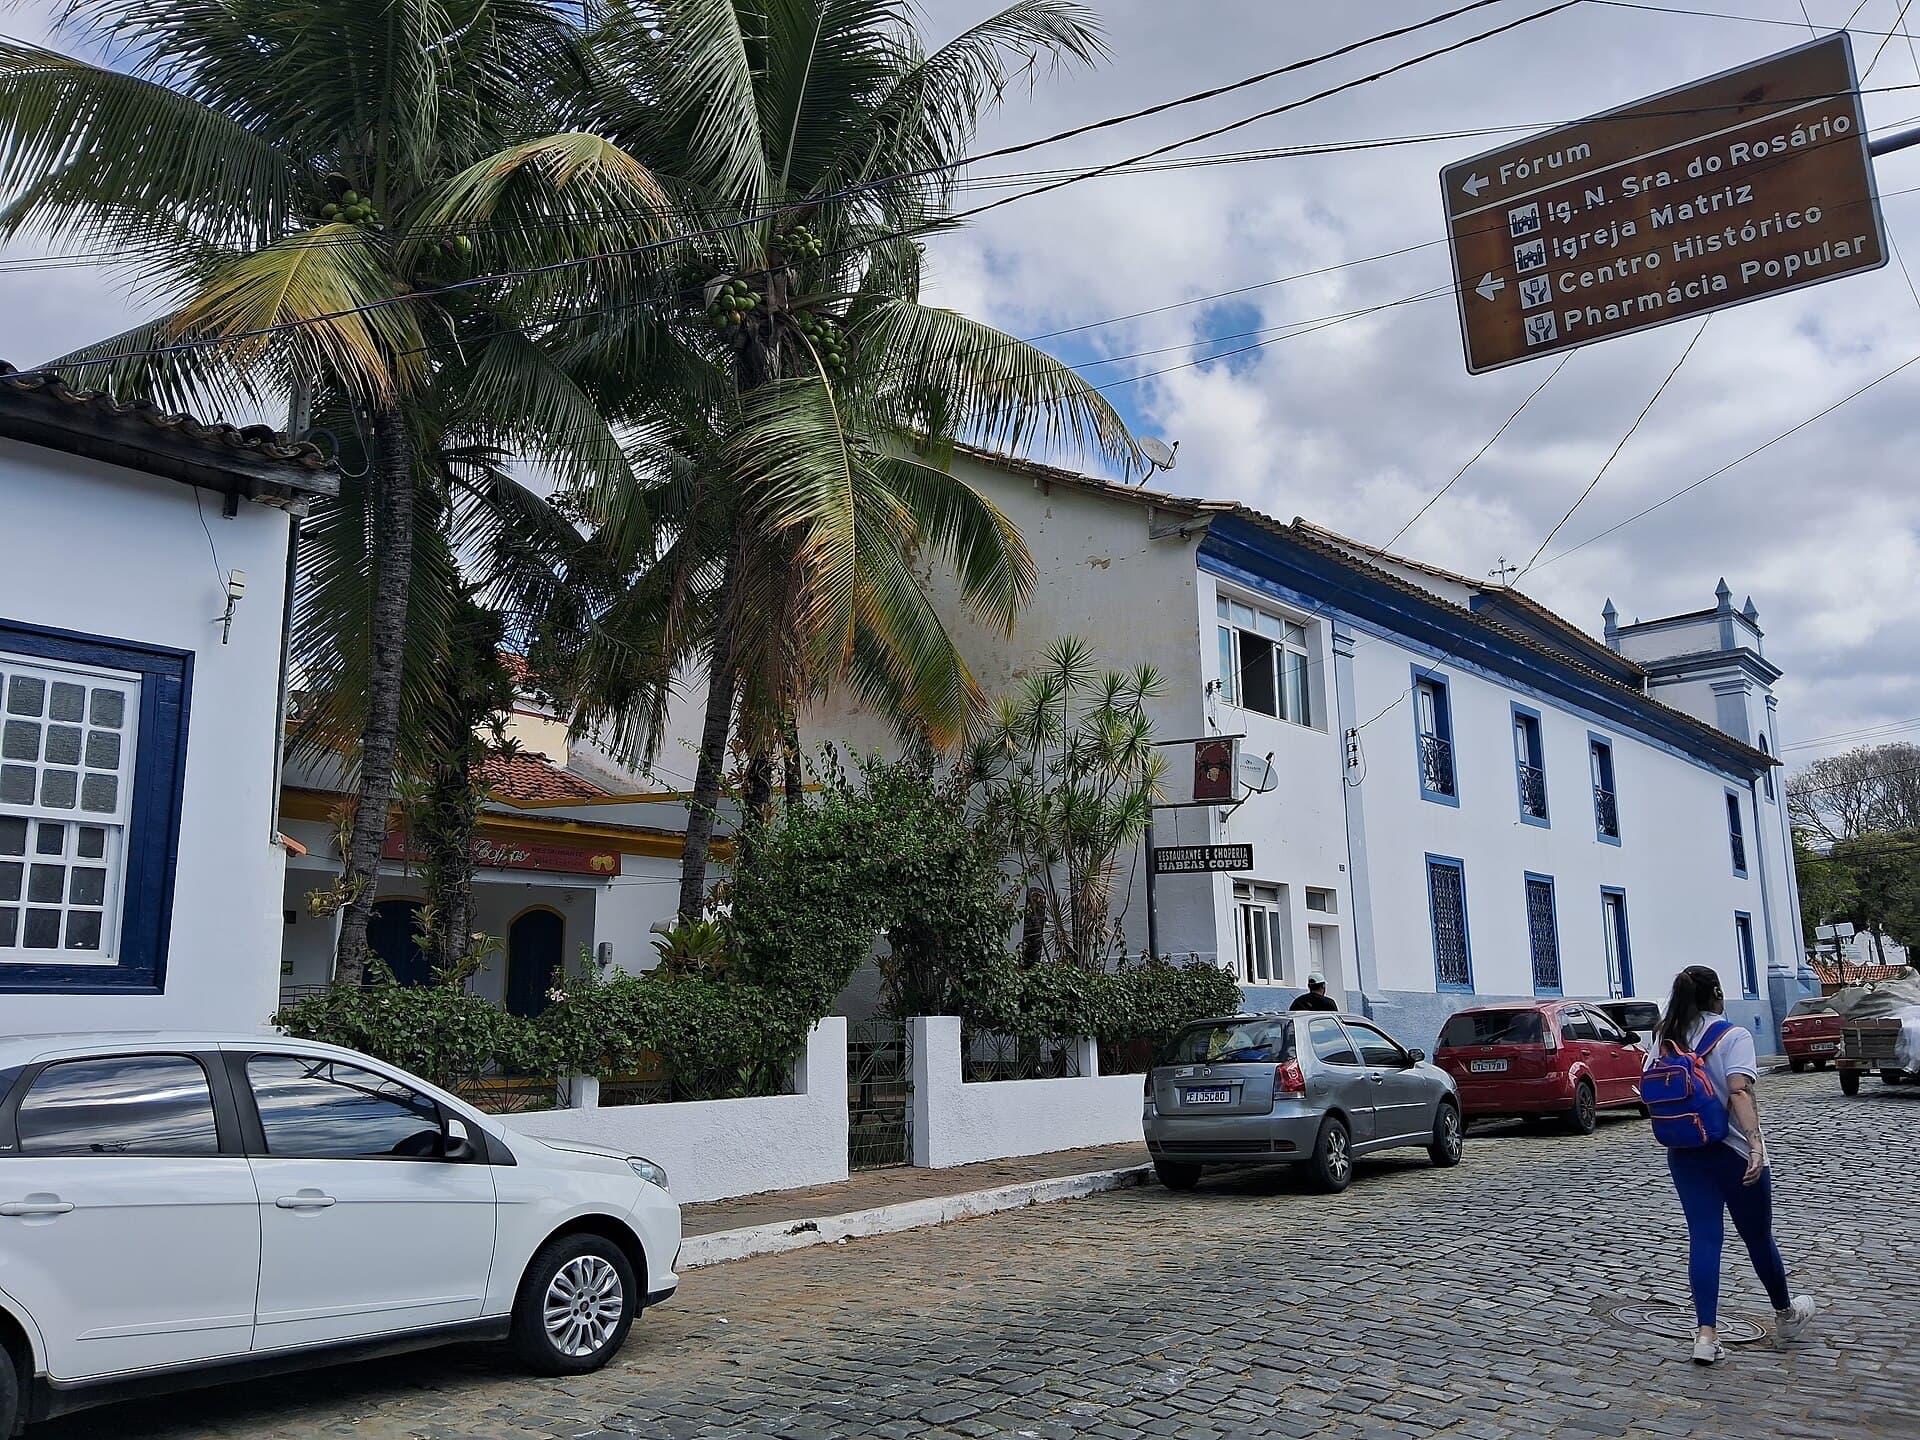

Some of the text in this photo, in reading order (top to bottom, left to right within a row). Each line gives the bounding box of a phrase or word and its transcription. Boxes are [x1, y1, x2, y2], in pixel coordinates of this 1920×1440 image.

[1500, 143, 1591, 185] Fórum
[1547, 115, 1850, 224] Ig. N. Sra. do Rosário
[1552, 184, 1754, 259] Igreja Matriz
[1558, 206, 1822, 293] Centro Histórico
[1564, 232, 1867, 331] Pharmácia Popular
[1157, 847, 1248, 862] RESTAURANTE E CHOPERIA
[1157, 859, 1249, 871] HABEAS COPUS
